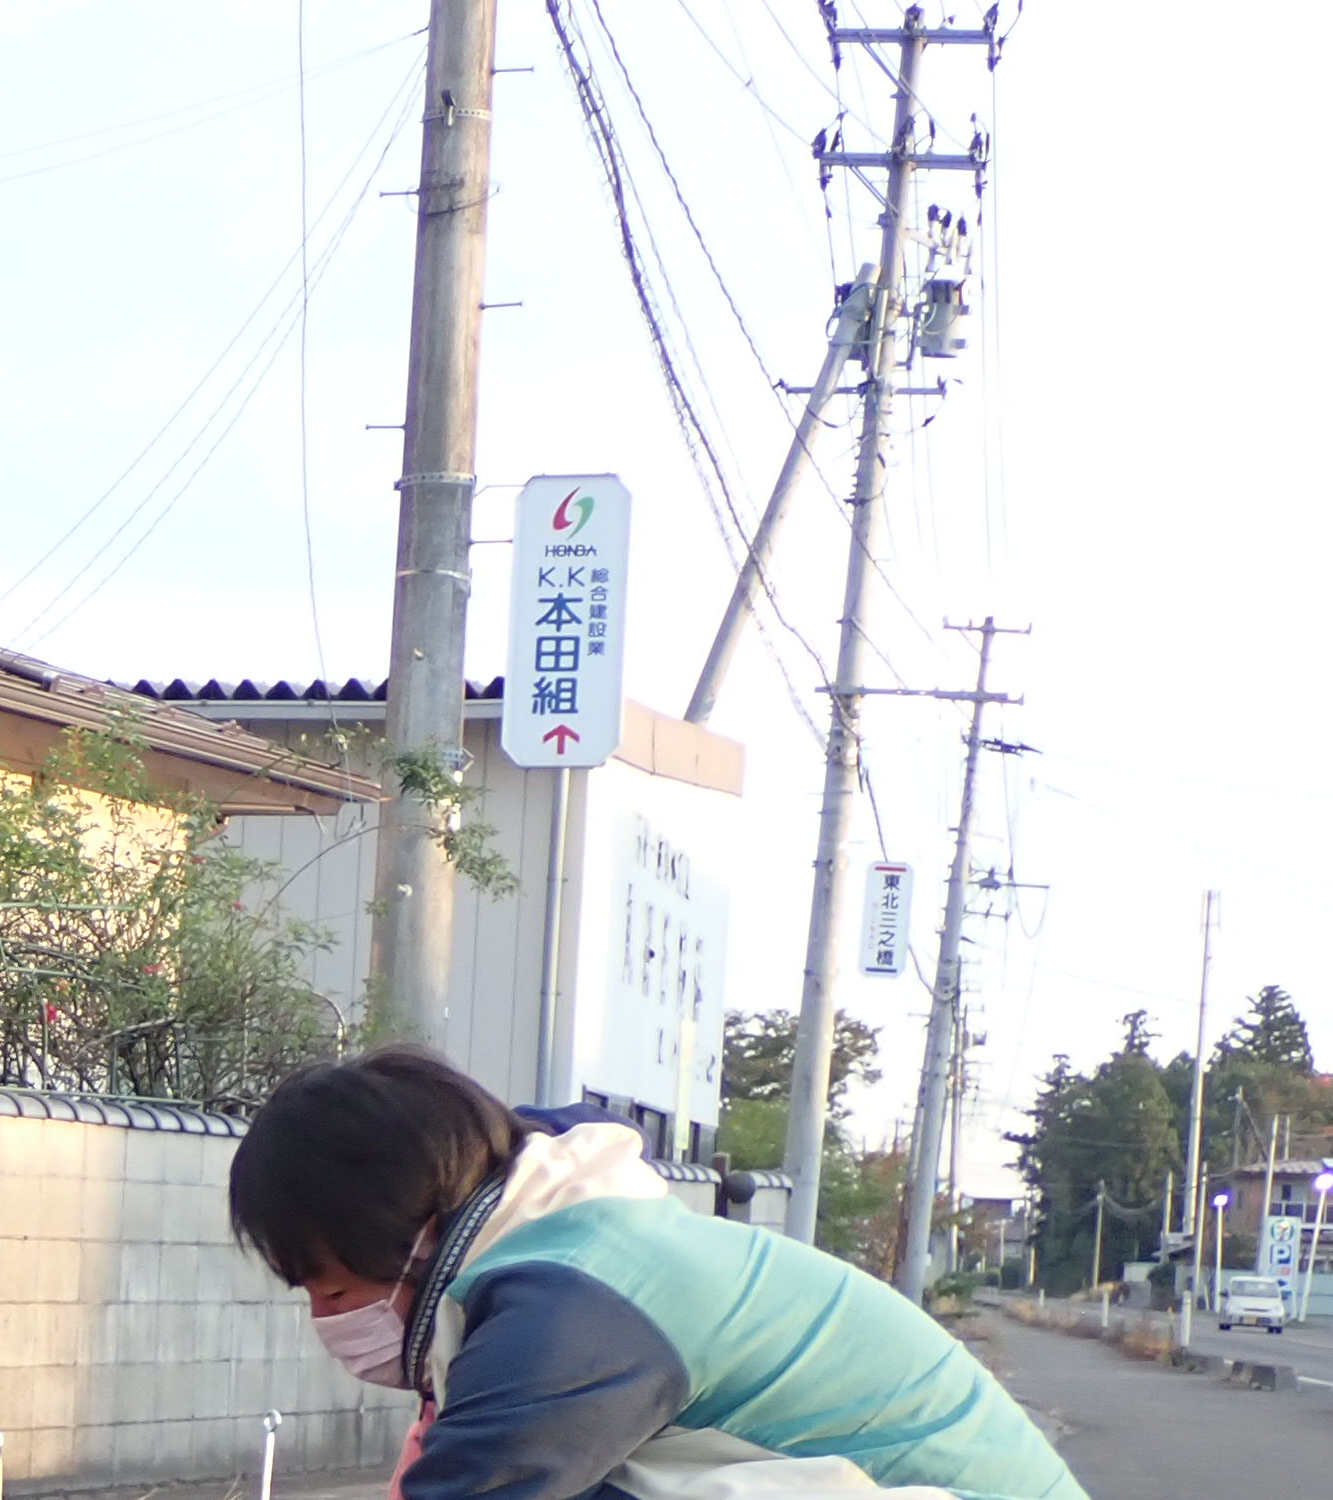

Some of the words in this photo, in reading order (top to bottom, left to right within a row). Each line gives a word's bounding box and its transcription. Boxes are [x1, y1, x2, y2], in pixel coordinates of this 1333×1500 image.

[538, 566, 585, 587] K.K
[587, 567, 610, 656] 総合建設業
[531, 592, 583, 716] 本田組
